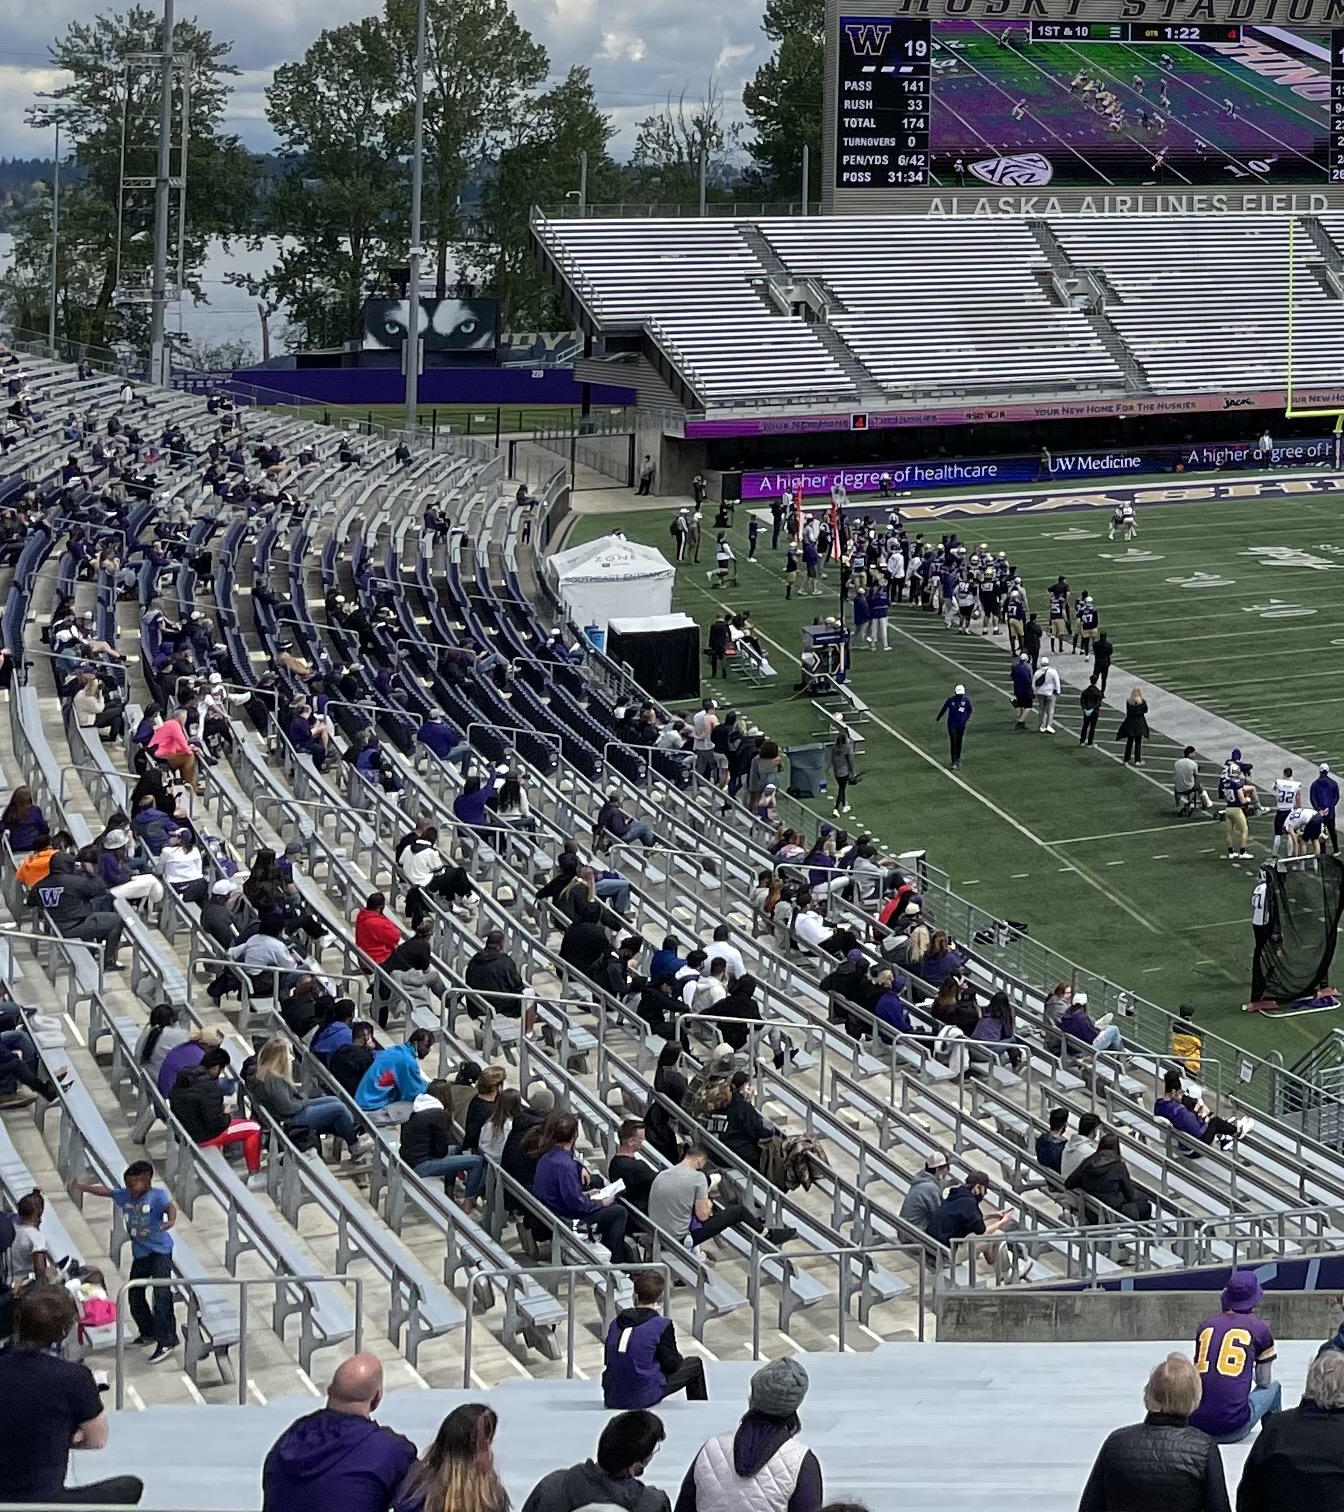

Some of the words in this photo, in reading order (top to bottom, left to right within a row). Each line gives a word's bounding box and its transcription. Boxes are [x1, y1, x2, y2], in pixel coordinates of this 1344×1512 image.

[1037, 26, 1062, 37] 1ST
[1063, 26, 1073, 37] &
[1075, 26, 1089, 37] 10
[1164, 28, 1200, 40] 1:22
[845, 24, 892, 56] W
[904, 39, 928, 57] 19
[844, 81, 873, 92] PASS
[902, 81, 925, 92] 141
[844, 99, 873, 111] RUSH
[907, 100, 923, 111] 33
[843, 118, 877, 129] TOTAL
[901, 118, 925, 130] 174
[843, 137, 896, 147] TURNOVERS
[907, 136, 916, 147] 0
[1337, 136, 1344, 147] 2
[843, 155, 889, 166] PEN/YDS
[897, 155, 925, 167] 6/42
[843, 172, 872, 183] POSS
[887, 171, 924, 183] 31:34
[927, 196, 1063, 216] ALASKA
[1079, 194, 1228, 216] AIRLINES
[1242, 193, 1329, 214] FIELD
[1035, 407, 1059, 416] YOUR
[1061, 406, 1084, 415] NEW
[1086, 405, 1114, 414] HOME
[1116, 404, 1134, 413] FOR
[1136, 402, 1154, 411] THE
[1156, 401, 1197, 410] HUSKIES
[1188, 450, 1199, 464] A
[1203, 447, 1249, 466] higher
[1307, 441, 1324, 458] of
[1049, 456, 1076, 473] UW
[1077, 454, 1142, 471] Medicine
[760, 476, 773, 491] A
[776, 473, 827, 494] higher
[894, 466, 912, 482] of
[914, 461, 998, 481] healthcare
[1277, 790, 1294, 803] 32
[39, 887, 64, 907] W
[1194, 1327, 1253, 1377] 16
